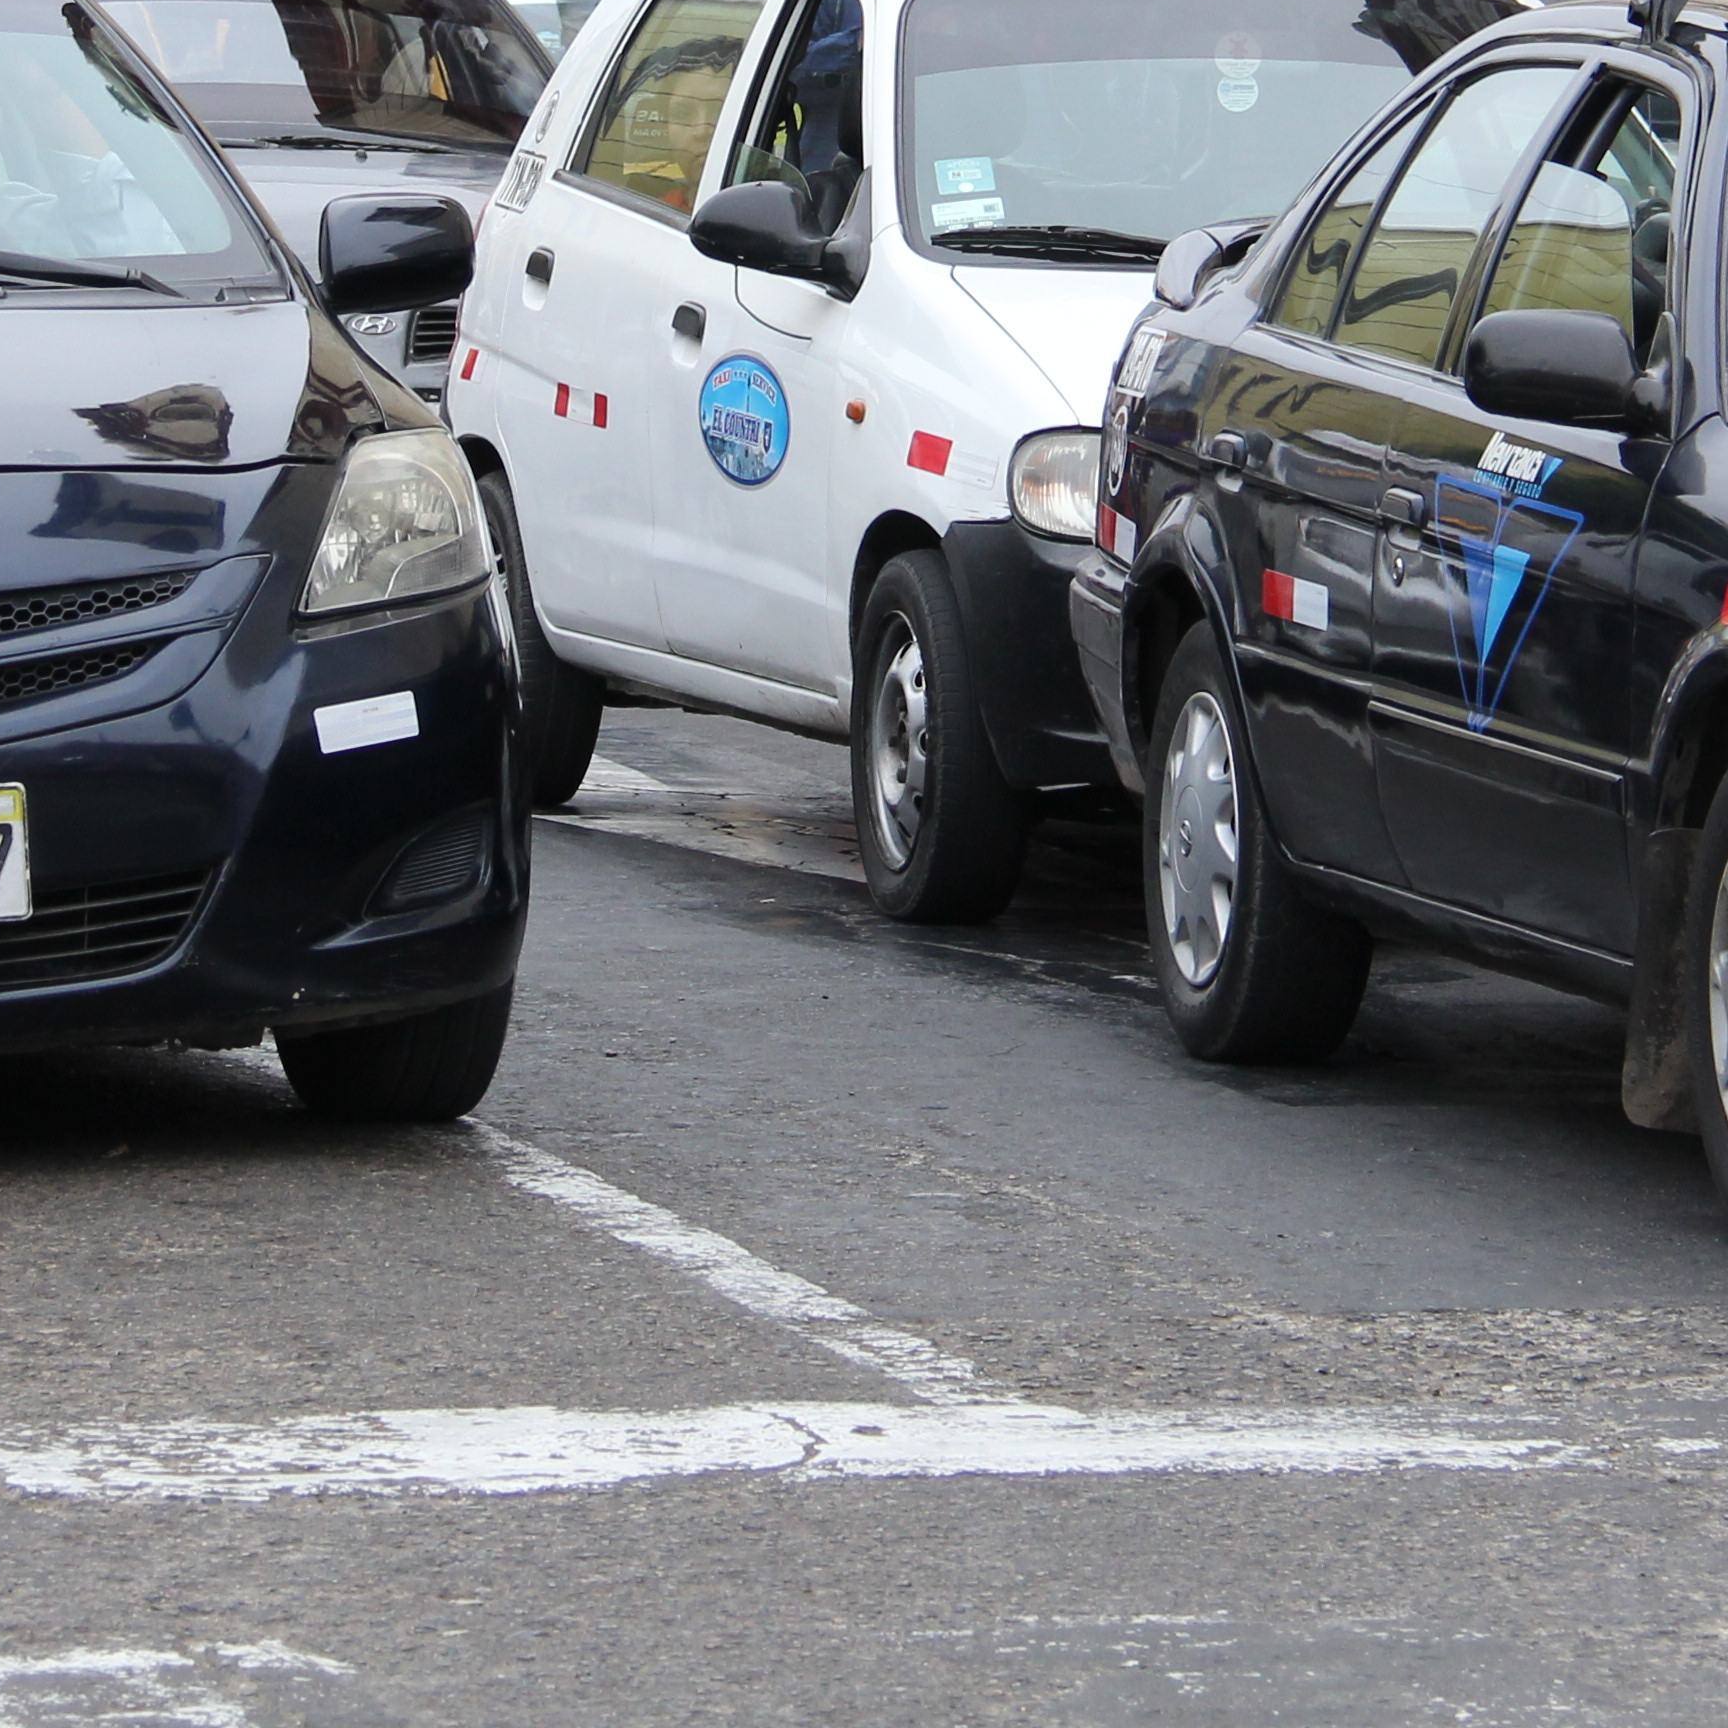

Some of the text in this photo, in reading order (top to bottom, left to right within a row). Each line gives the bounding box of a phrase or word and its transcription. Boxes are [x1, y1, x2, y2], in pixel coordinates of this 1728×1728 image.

[712, 369, 732, 389] TAXI
[712, 406, 761, 443] EL COUNTRI
